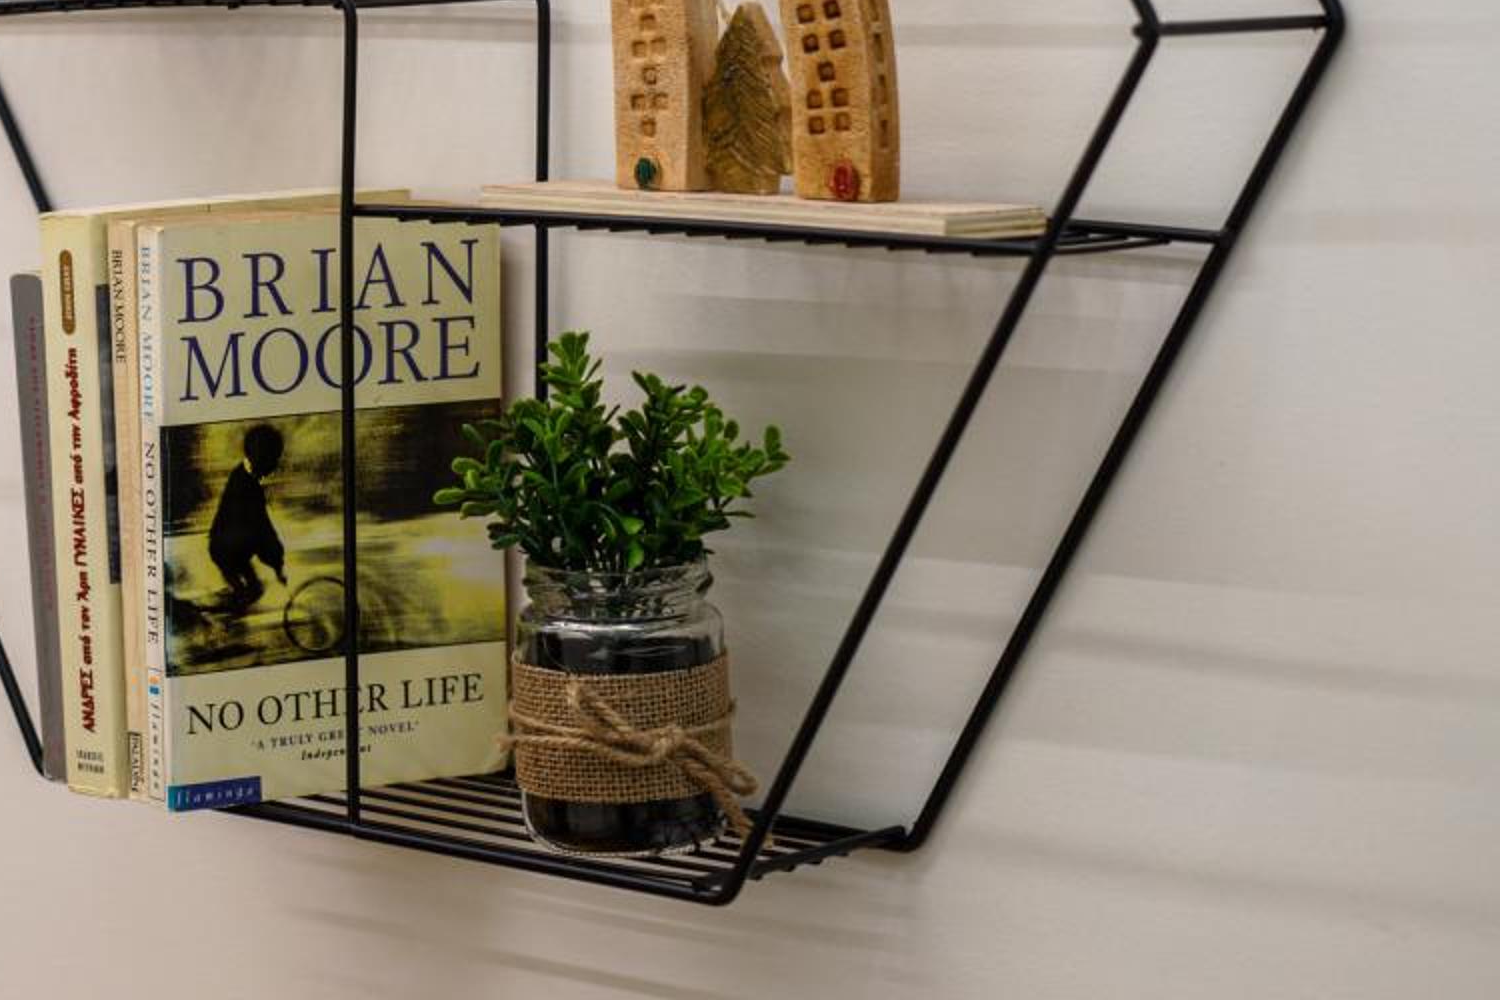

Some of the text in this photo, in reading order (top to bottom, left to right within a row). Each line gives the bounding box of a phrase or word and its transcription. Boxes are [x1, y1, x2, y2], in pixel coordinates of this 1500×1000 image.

[111, 249, 127, 364] BRIAN MOORE
[176, 238, 479, 324] BRIAN
[179, 315, 481, 403] MOORE
[140, 247, 159, 644] BRIAN MOORE NO OTHER LIFE
[70, 487, 88, 567] ΓΥΝΑΙΚΕΣ
[79, 668, 96, 734] ΑΝΔΡΕΣ
[186, 700, 245, 735] NO
[402, 673, 485, 709] LIFE
[270, 733, 314, 748] TRULY
